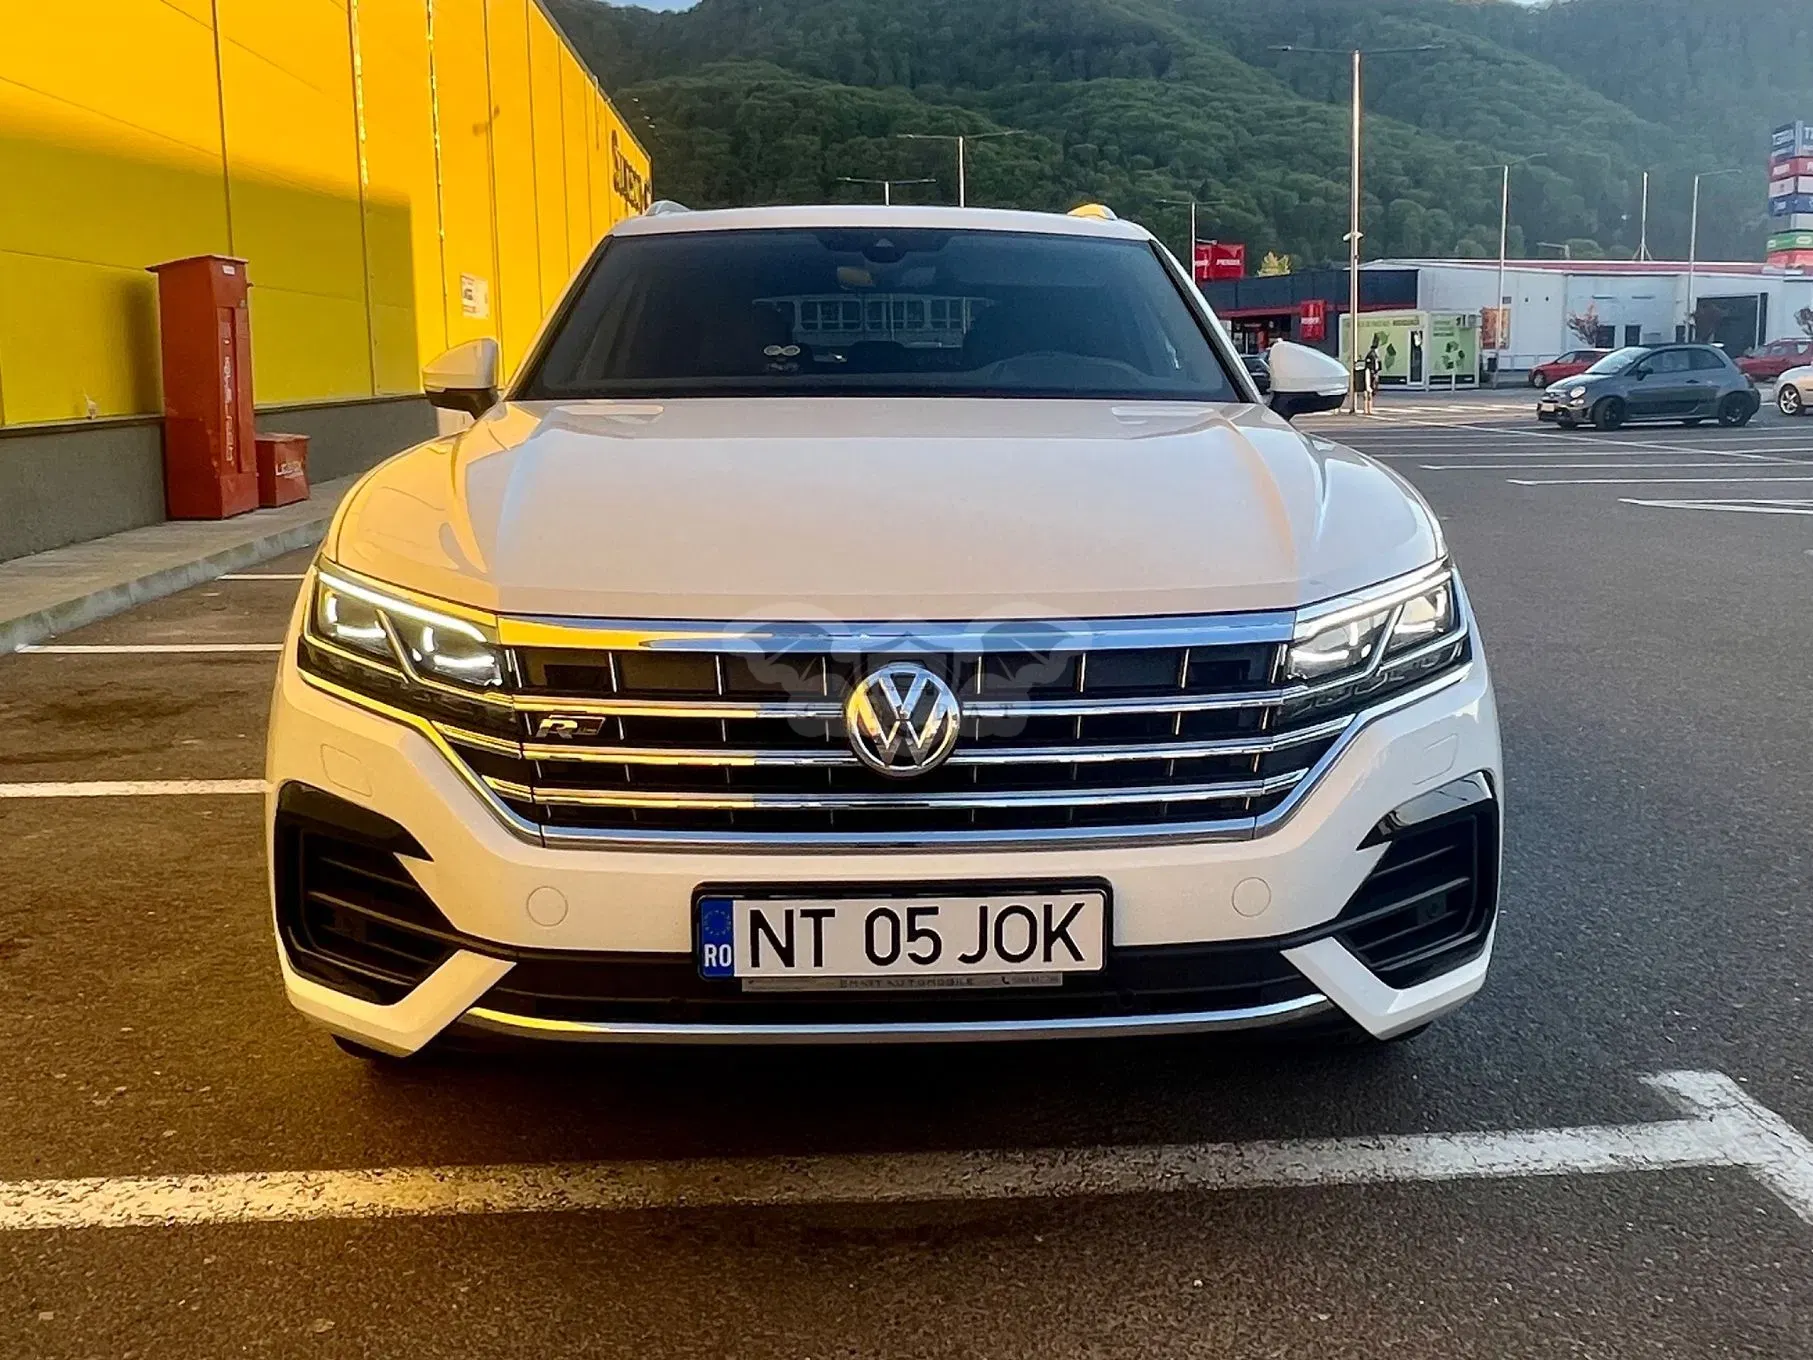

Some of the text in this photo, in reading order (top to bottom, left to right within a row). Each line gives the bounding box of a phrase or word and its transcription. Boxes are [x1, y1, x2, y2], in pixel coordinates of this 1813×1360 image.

[704, 943, 732, 967] RO
[749, 902, 1086, 969] NT 05 JOK
